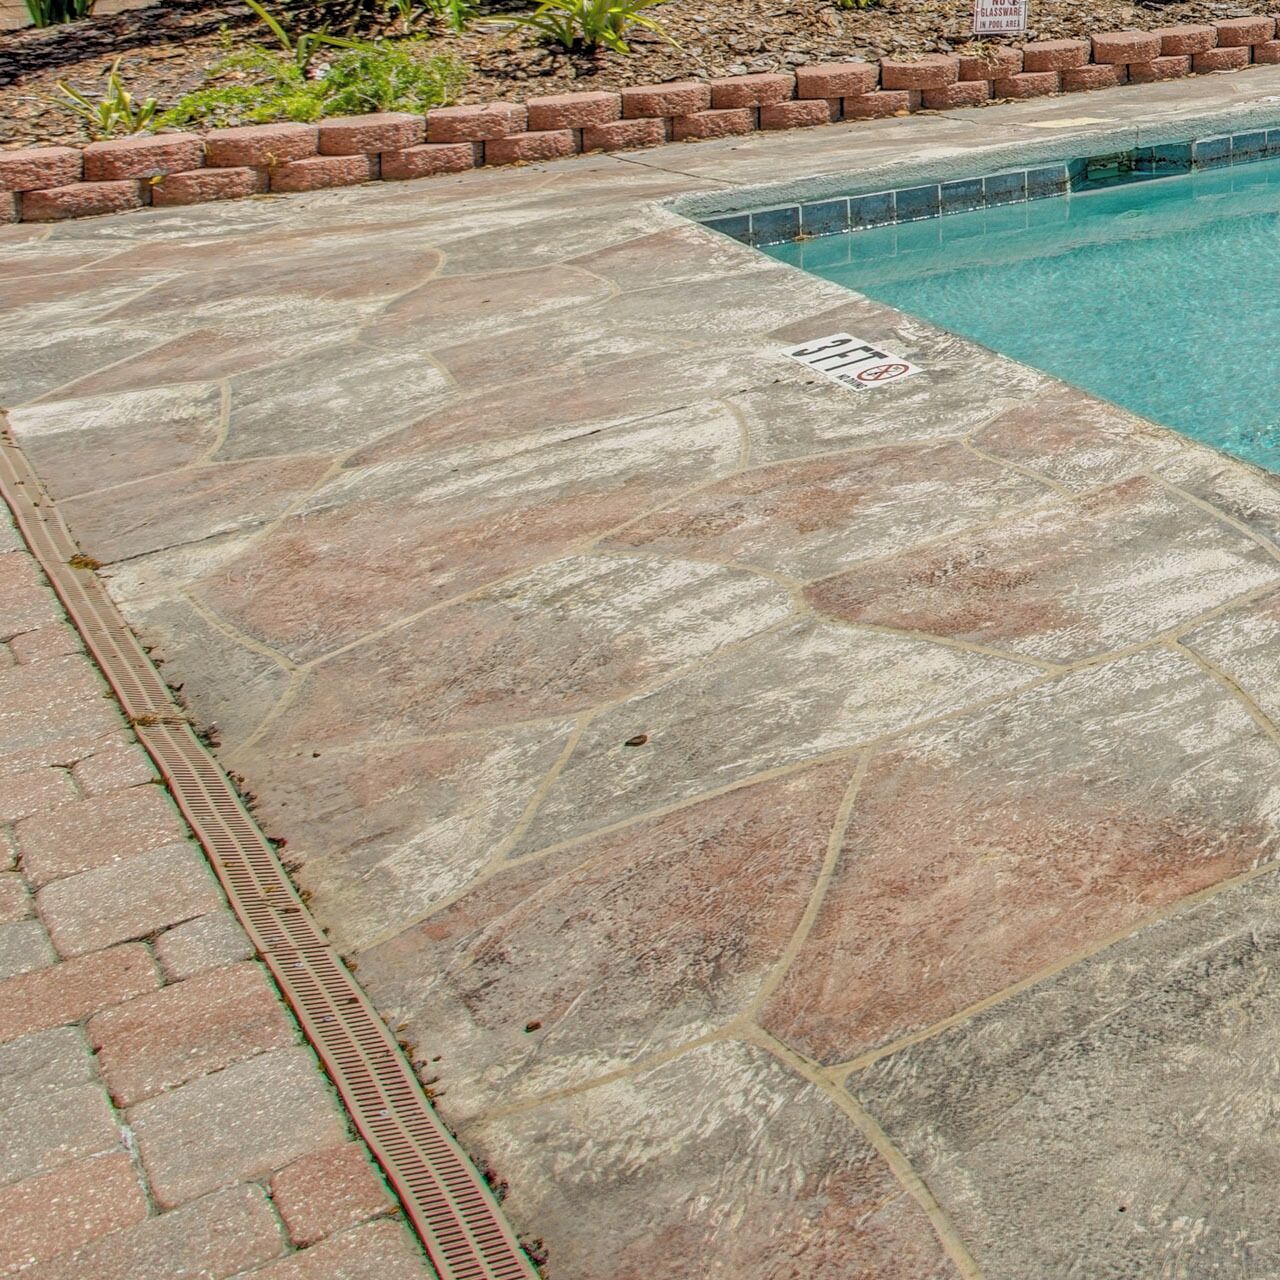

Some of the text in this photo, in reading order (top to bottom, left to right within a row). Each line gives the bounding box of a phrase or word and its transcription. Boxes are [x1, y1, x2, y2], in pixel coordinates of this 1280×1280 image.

[981, 7, 1022, 17] GLASSWARE
[980, 19, 1021, 28] IN POOL AREA
[791, 338, 889, 372] 3 FT
